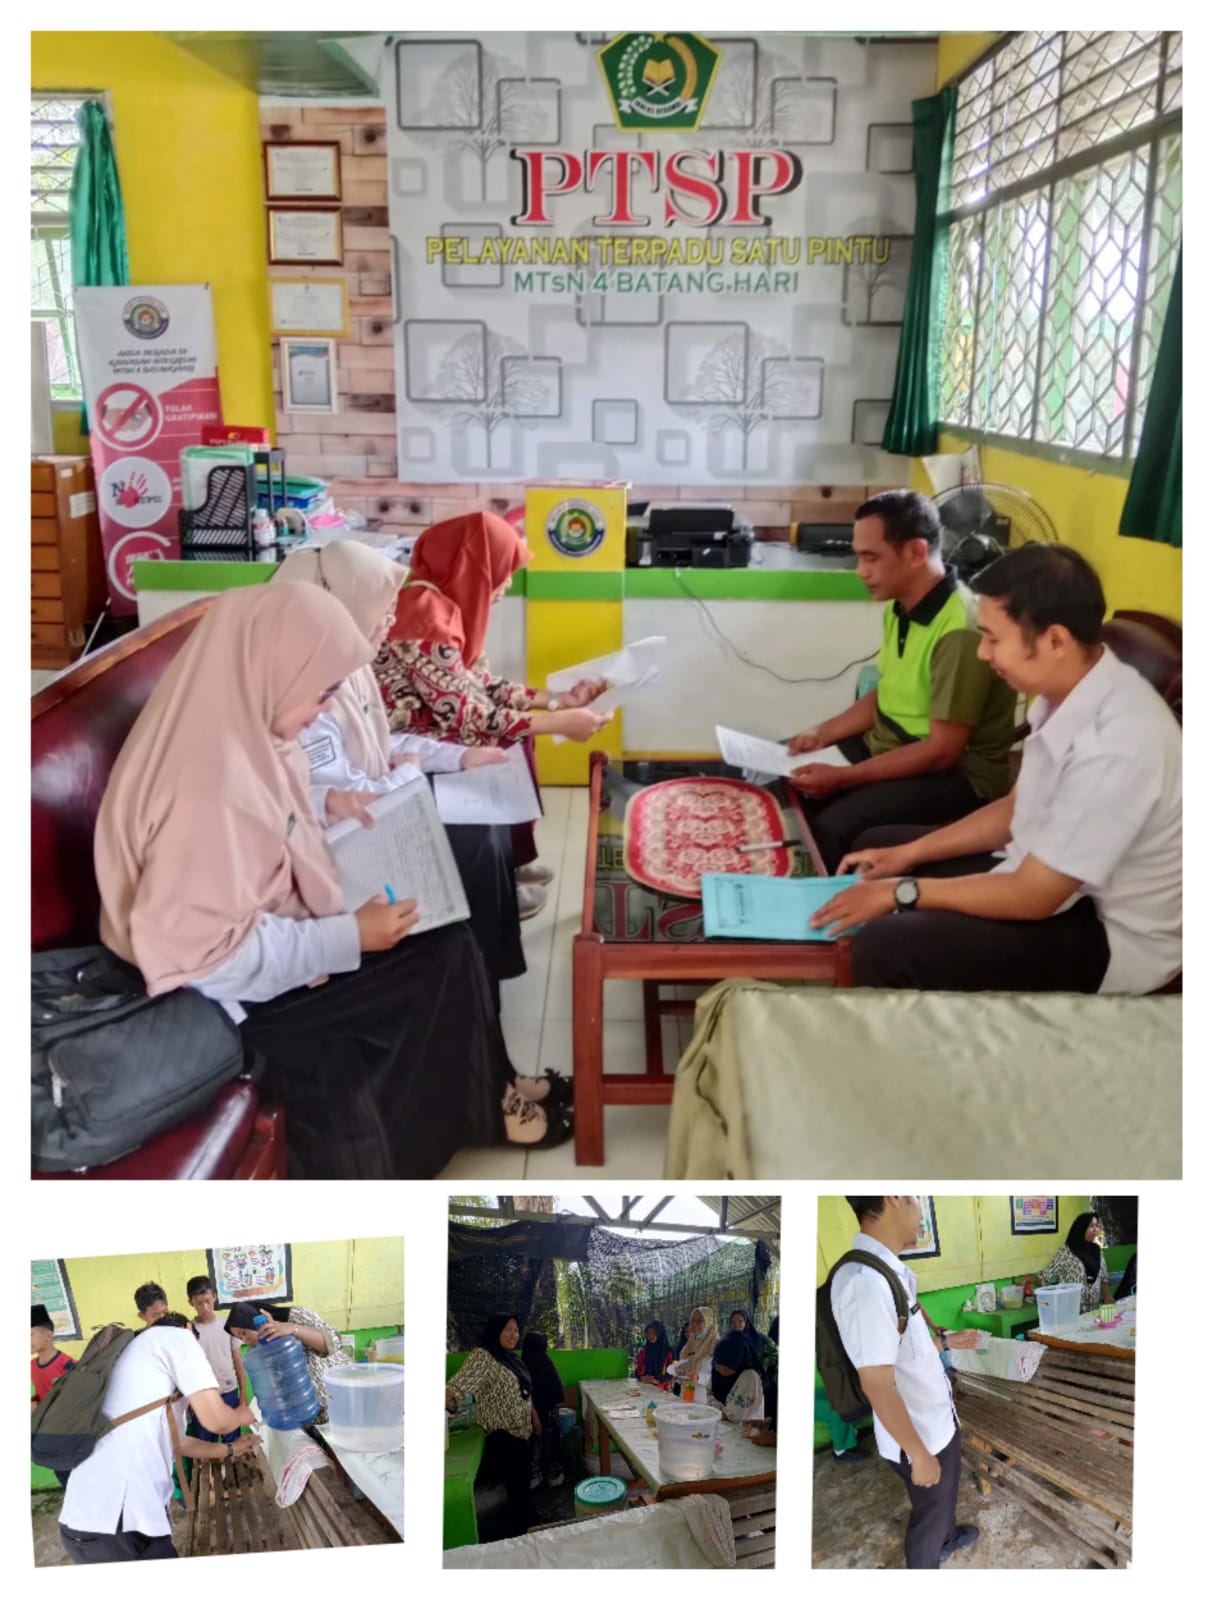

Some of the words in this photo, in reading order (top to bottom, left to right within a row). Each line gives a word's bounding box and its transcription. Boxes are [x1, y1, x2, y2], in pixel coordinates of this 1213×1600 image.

[510, 149, 803, 227] PTSP
[425, 236, 591, 265] PELAYANAN
[597, 236, 724, 266] TERPADU
[730, 236, 800, 266] SATU
[807, 236, 891, 265] PINTU
[514, 271, 584, 293] MTsN
[592, 271, 609, 293] 4
[616, 271, 724, 293] BATANG
[733, 271, 799, 293] HARI
